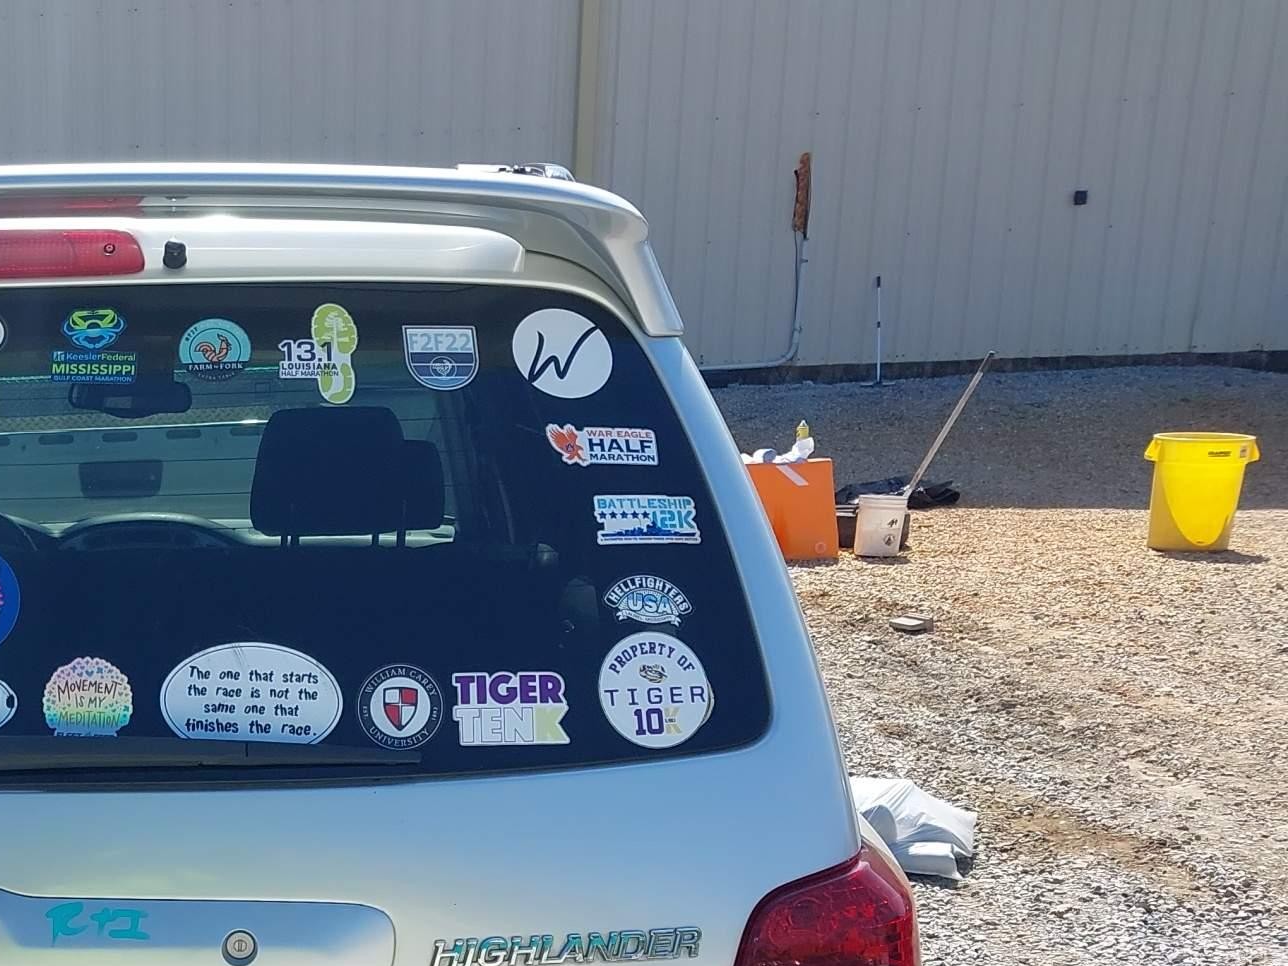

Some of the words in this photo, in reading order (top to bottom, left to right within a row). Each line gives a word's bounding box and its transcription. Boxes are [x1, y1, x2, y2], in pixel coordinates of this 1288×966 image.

[408, 333, 473, 351] F2F22
[281, 341, 332, 362] 13.1
[52, 363, 136, 376] MISSISSIPPI
[219, 362, 243, 370] FORK
[281, 362, 338, 370] LOUISIANA
[586, 430, 612, 438] WAR
[617, 430, 653, 439] EAGLE
[588, 438, 653, 453] HALF
[589, 453, 655, 462] MARATHON
[597, 498, 692, 510] BATTLESHIP
[651, 510, 695, 529] 12K
[608, 577, 689, 611] HELLFIGHTERS
[627, 592, 672, 614] USA
[608, 642, 676, 674] PROPERTY
[677, 655, 695, 671] OF
[189, 666, 210, 680] The
[219, 670, 240, 680] one
[249, 669, 274, 682] that
[282, 671, 319, 684] starts
[365, 668, 406, 693] WILLIAM
[409, 671, 437, 696] CAREY
[57, 679, 123, 702] MOVEMENT
[187, 684, 207, 696] the
[216, 687, 242, 698] race
[250, 687, 261, 698] is
[270, 688, 289, 700] not
[298, 688, 318, 700] the
[455, 674, 563, 704] TIGER
[604, 686, 706, 706] TIGER
[75, 696, 84, 708] IS
[88, 697, 106, 708] MY
[204, 702, 236, 714] same
[244, 704, 266, 714] one
[274, 704, 299, 716] that
[58, 711, 121, 728] MEDITATION
[185, 718, 239, 733] finishes
[249, 720, 271, 734] the
[281, 723, 317, 736] race.
[456, 706, 569, 743] TENK
[370, 726, 429, 747] UNIVERSITY
